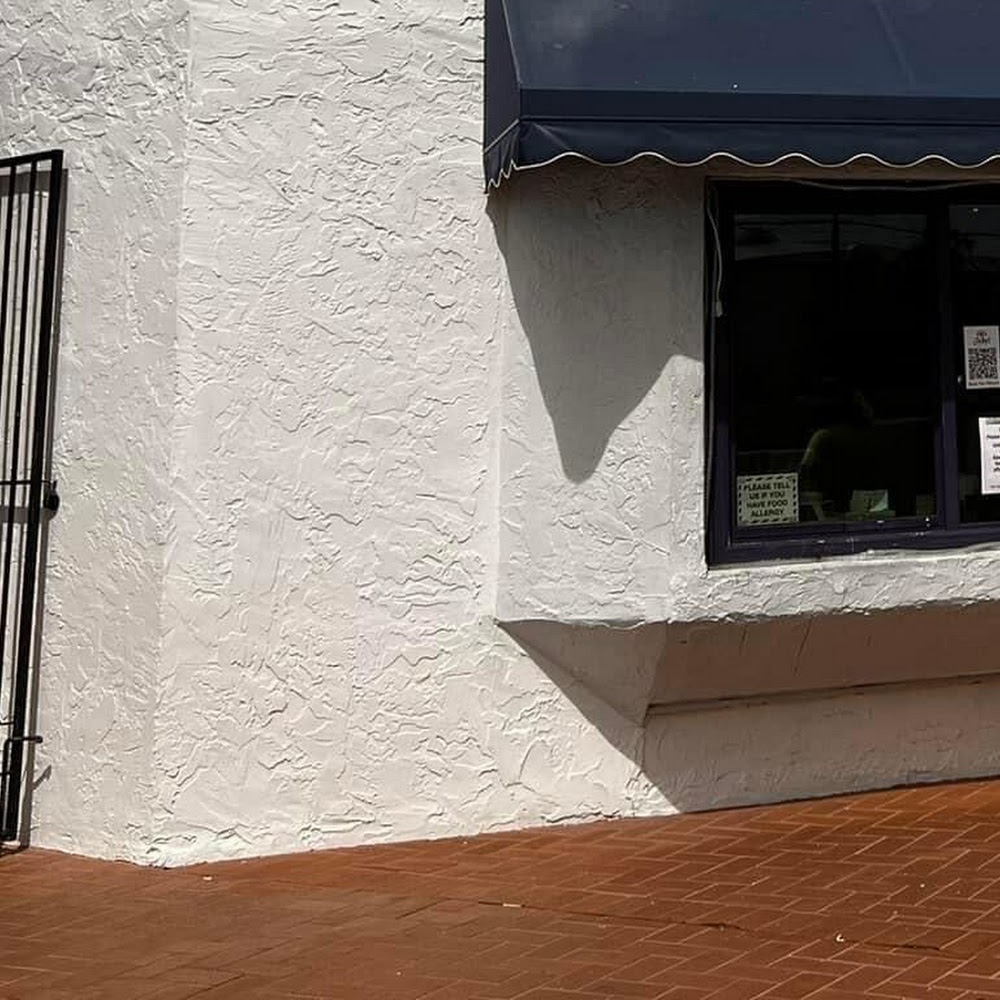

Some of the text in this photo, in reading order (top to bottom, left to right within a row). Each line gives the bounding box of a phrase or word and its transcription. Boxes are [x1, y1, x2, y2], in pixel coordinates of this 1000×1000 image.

[743, 481, 791, 491] PLEASE TELL
[749, 492, 760, 500] US
[769, 491, 786, 499] YOU
[746, 499, 788, 508] HAVE FOOD
